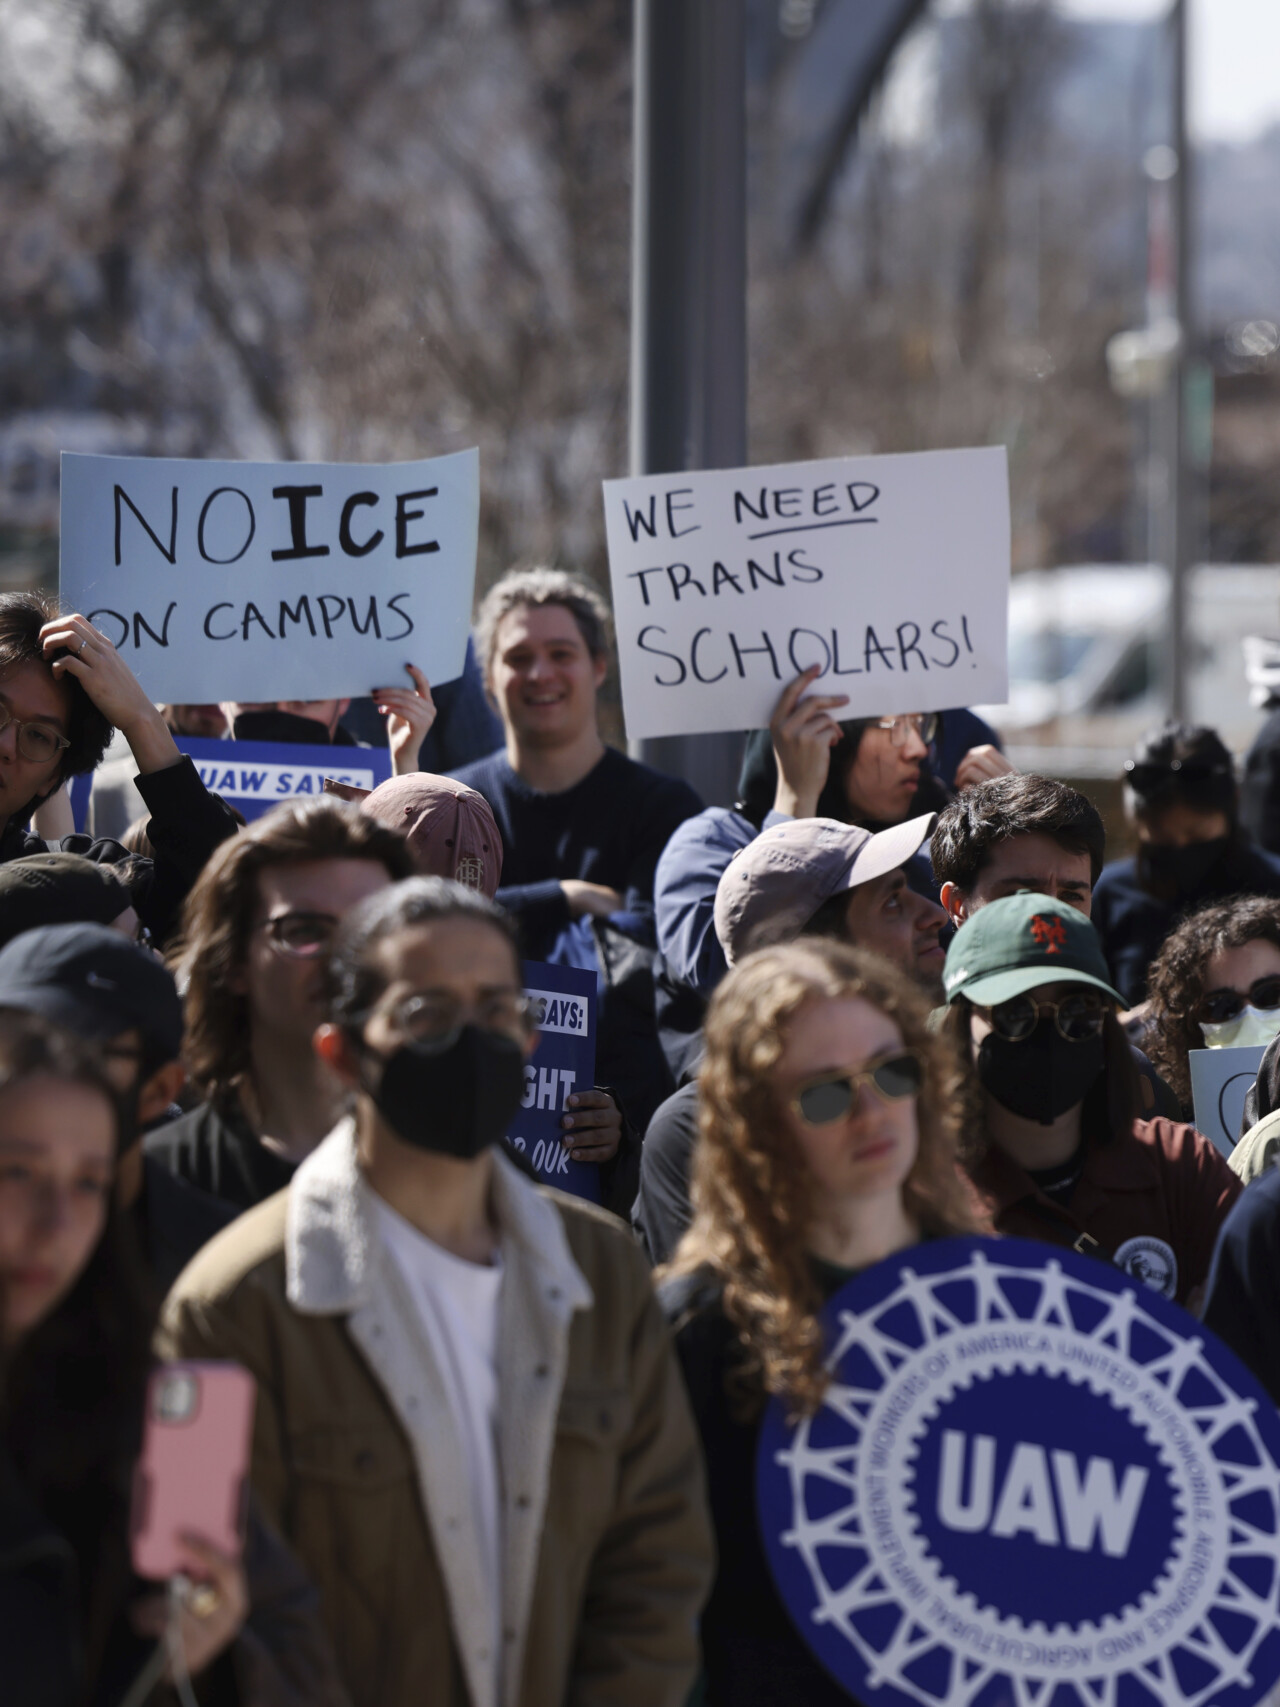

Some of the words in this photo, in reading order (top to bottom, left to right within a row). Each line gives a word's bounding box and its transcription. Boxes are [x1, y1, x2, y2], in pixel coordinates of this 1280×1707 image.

[623, 488, 700, 542] WE
[734, 482, 880, 523] NEED
[627, 549, 824, 605] TRANS
[86, 601, 178, 649] ON
[203, 593, 414, 641] CAMPUS
[637, 615, 977, 686] SCHOLARS!
[199, 767, 268, 793] UAW
[520, 1065, 576, 1112] GHT
[922, 1350, 951, 1379] OF
[957, 1330, 1051, 1360] AMERICA
[937, 1430, 1149, 1558] UAW
